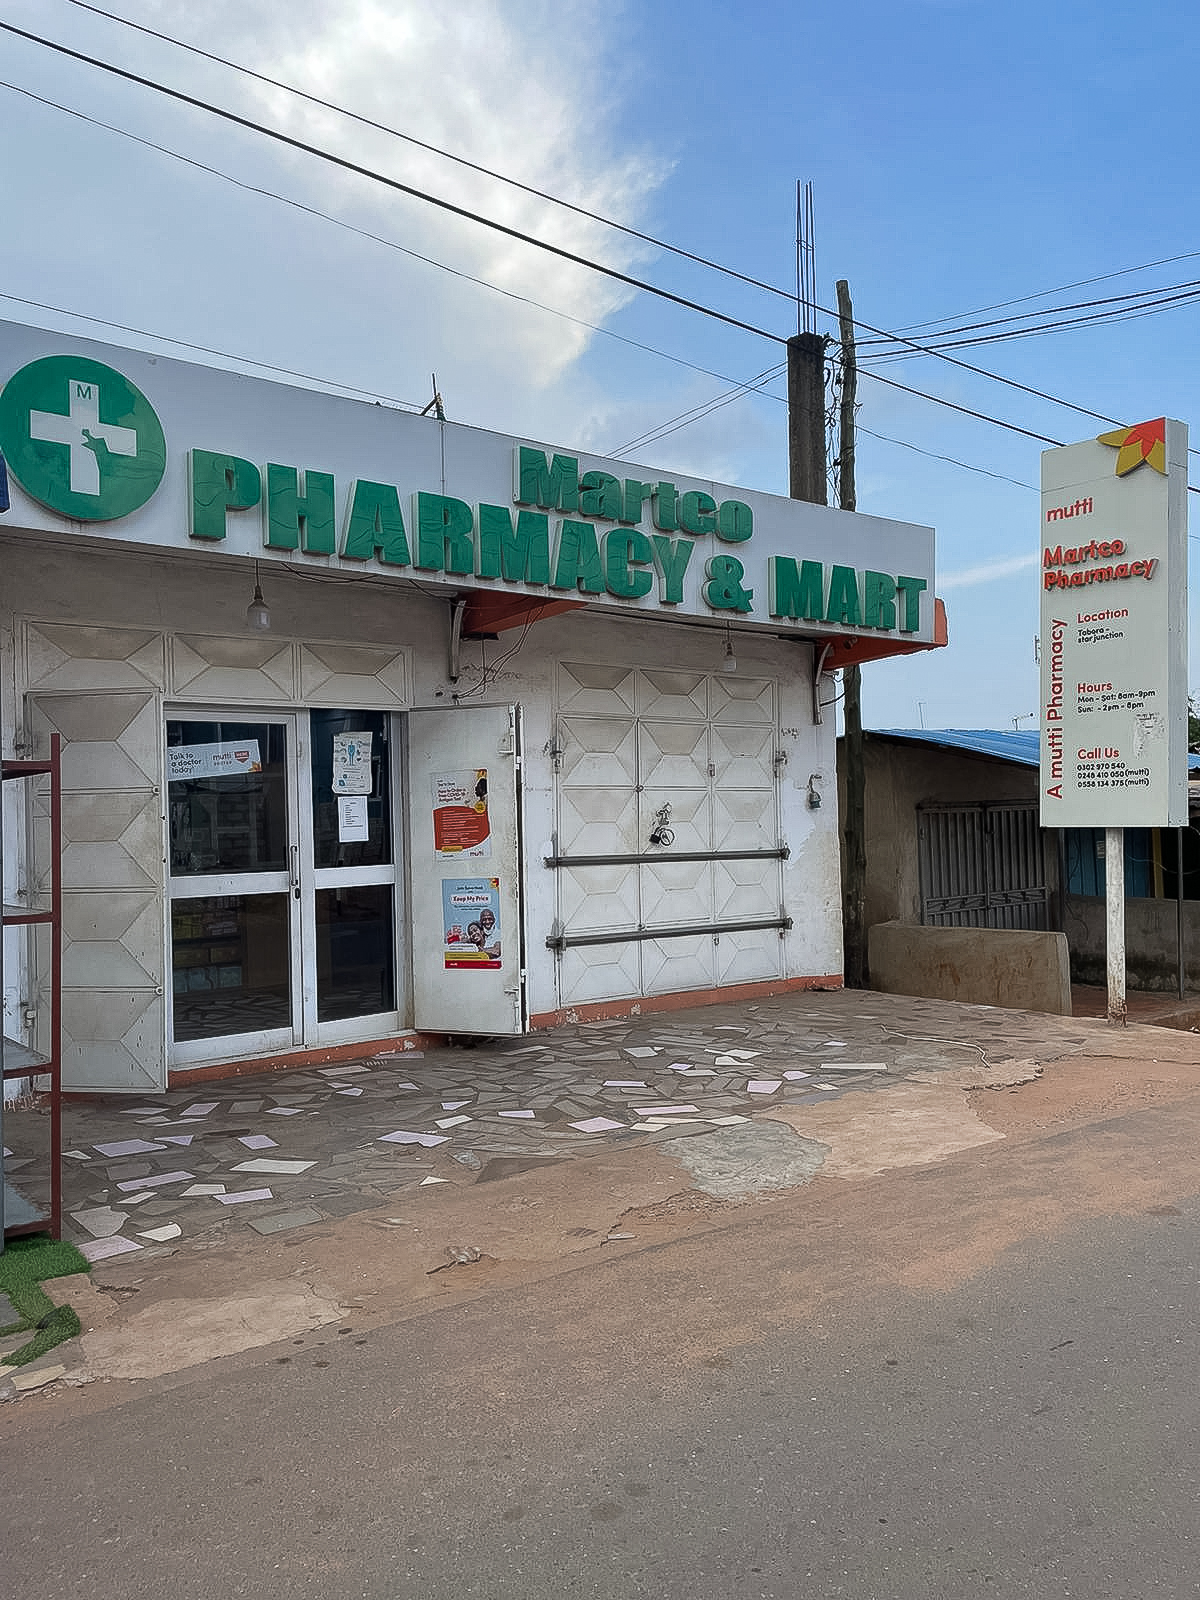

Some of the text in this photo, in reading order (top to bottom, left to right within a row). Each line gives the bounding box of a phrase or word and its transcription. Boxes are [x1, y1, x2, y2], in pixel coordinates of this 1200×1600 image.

[77, 384, 92, 400] M
[515, 446, 753, 543] Martco
[1047, 497, 1093, 522] mutti
[189, 447, 927, 632] PHARMACY & MART
[1043, 540, 1126, 568] Martco
[1044, 558, 1158, 591] Pharmacy
[1077, 608, 1128, 624] Location
[1093, 631, 1123, 643] junction
[1077, 683, 1112, 693] Hours
[1101, 693, 1116, 702] Sat:
[1046, 619, 1067, 799] A mutti Pharmacy
[169, 753, 185, 761] Talk
[213, 751, 232, 761] mutti
[1077, 747, 1120, 760] Call Us
[178, 759, 202, 767] doctor
